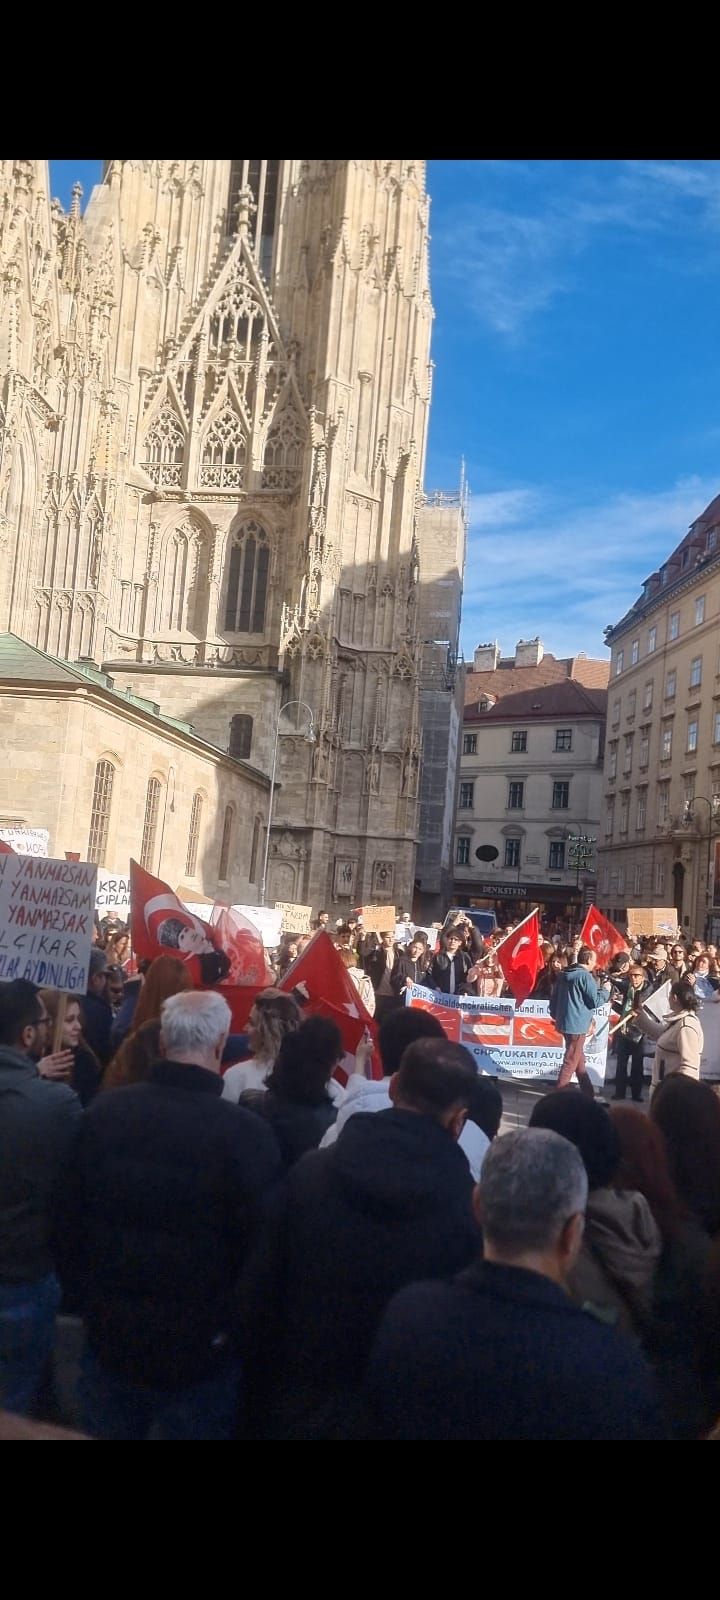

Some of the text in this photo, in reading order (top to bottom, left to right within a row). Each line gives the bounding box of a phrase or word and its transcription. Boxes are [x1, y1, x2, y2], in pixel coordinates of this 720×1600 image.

[482, 886, 527, 896] DENKSTEIN
[13, 933, 77, 958] ÇIKAR
[411, 986, 427, 998] CHP
[429, 990, 512, 1012] Sozialdemokratischer
[536, 1005, 543, 1013] in
[473, 1048, 493, 1056] CHP
[498, 1050, 537, 1059] YUKARI
